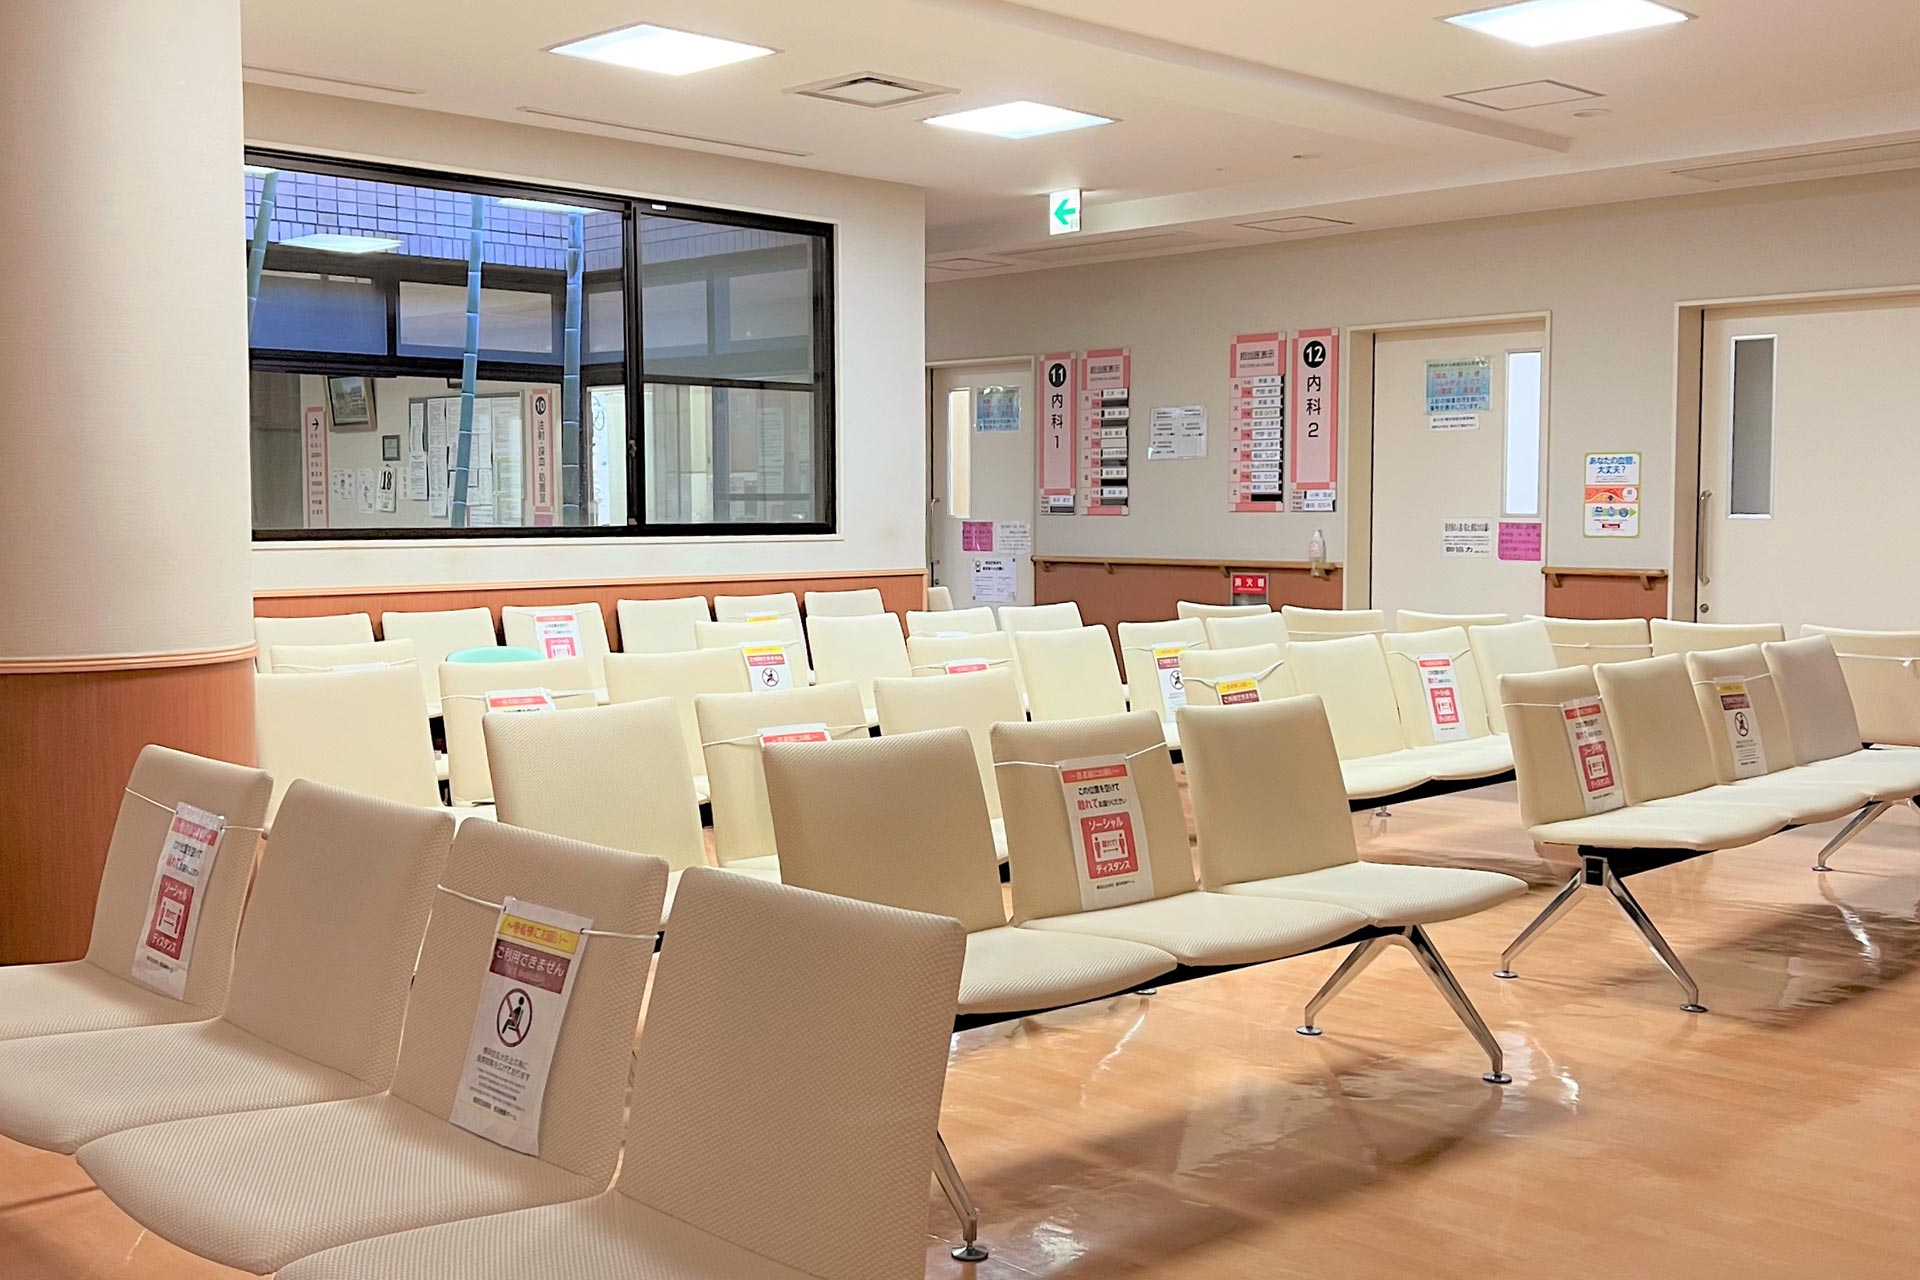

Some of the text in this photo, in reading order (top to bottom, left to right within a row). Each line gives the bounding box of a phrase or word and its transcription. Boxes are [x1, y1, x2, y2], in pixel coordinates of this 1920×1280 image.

[1306, 346, 1324, 362] 12
[1050, 367, 1065, 382] 11
[382, 470, 392, 490] 18
[1088, 817, 1124, 831] ソーシャル
[1095, 859, 1131, 875] ディスタンス
[163, 881, 188, 902] ソーシャル
[496, 944, 565, 977] ご利用できません
